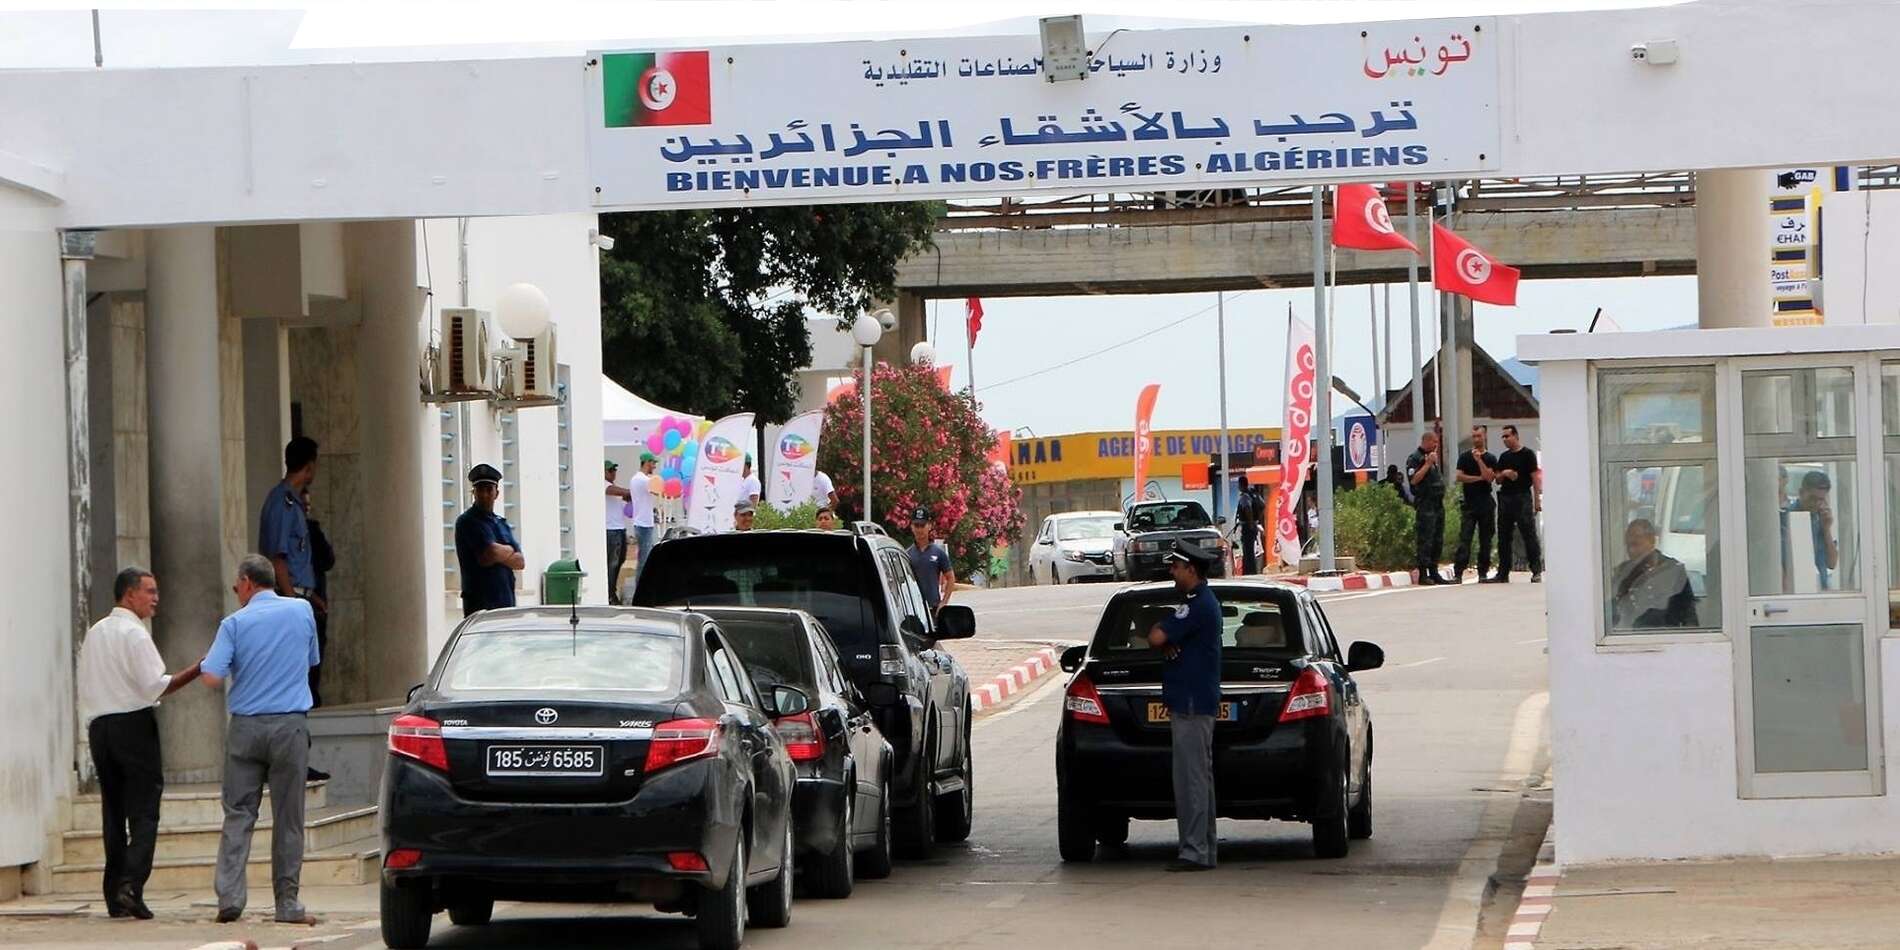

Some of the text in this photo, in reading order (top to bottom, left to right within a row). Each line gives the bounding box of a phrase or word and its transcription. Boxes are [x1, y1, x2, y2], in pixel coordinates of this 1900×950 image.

[862, 49, 1222, 87] وزارة السياح الصناعات التقليدية
[660, 100, 1418, 164] ترحب بالأشقاء الجزائريين
[666, 145, 1429, 192] BIENVENUE A NOS FRÈRES ALGÉRIENS
[1794, 172, 1815, 180] GAB
[1166, 435, 1187, 455] DE
[618, 720, 653, 728] YARIS
[494, 750, 523, 768] 185
[552, 750, 595, 769] 6585
